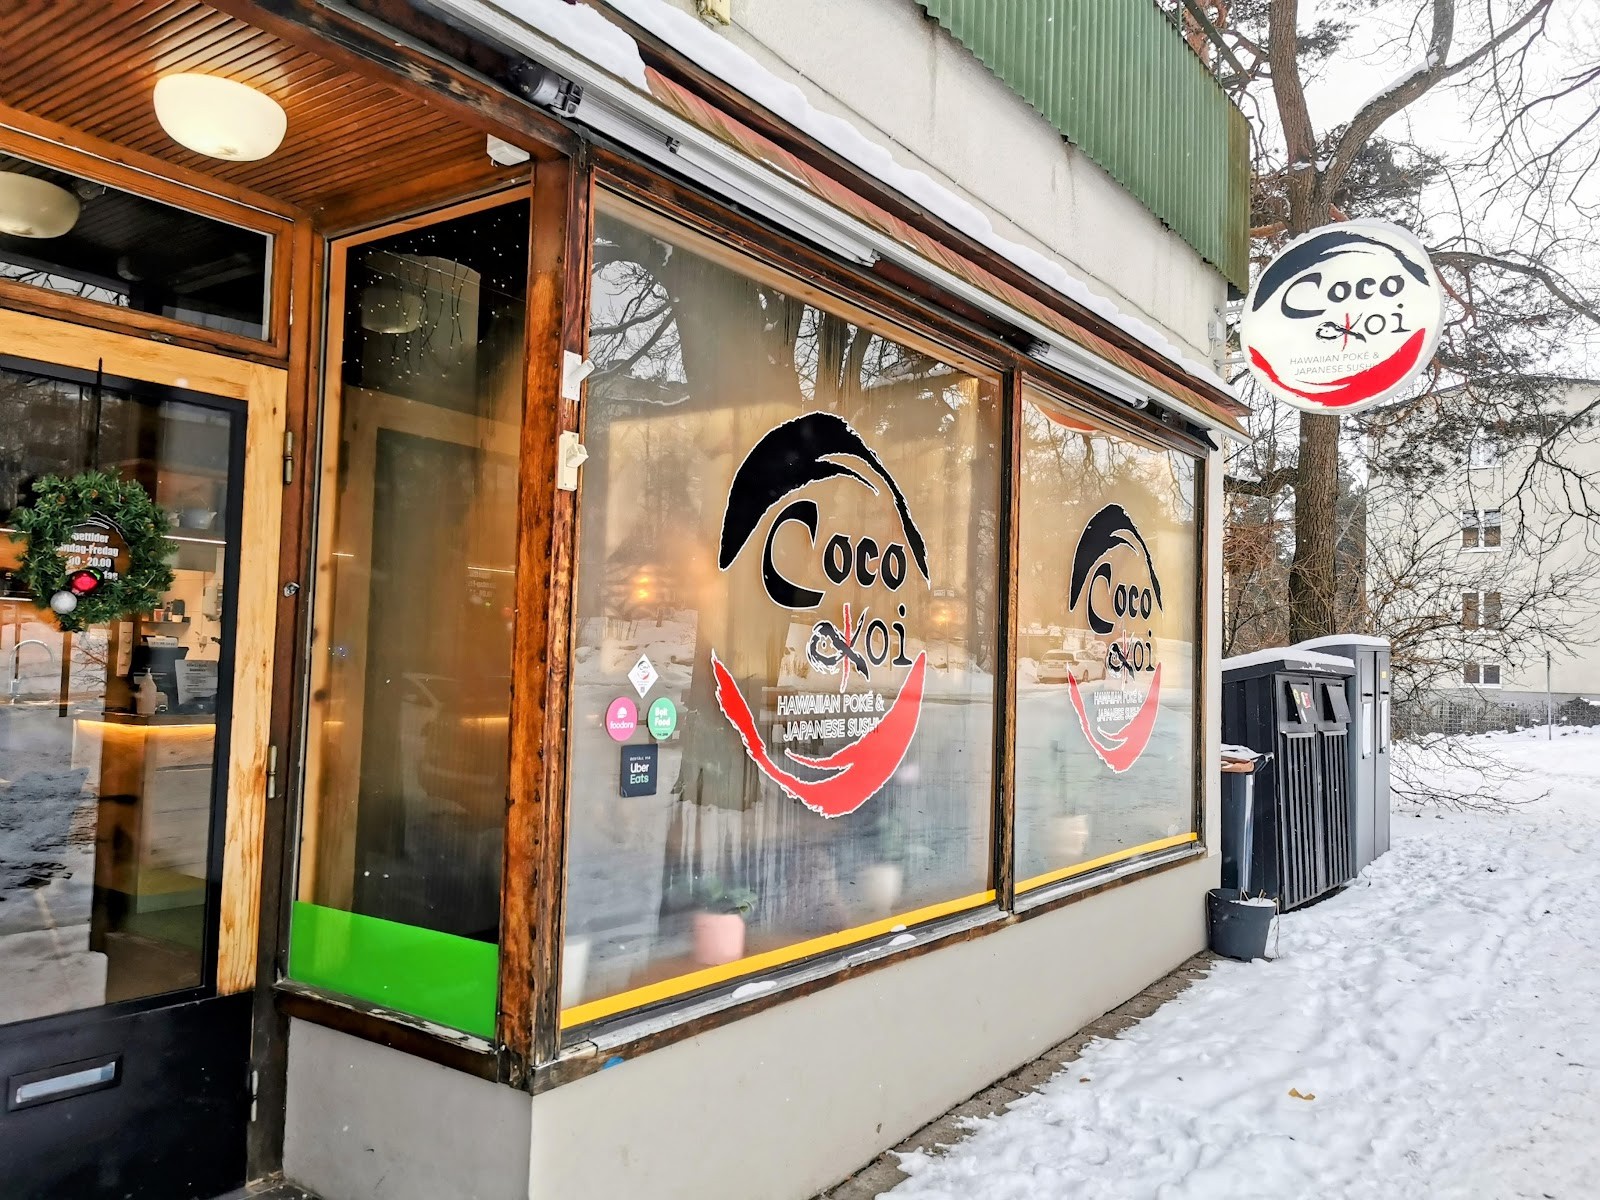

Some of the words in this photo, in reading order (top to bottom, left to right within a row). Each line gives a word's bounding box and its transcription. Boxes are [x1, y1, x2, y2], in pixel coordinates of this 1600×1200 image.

[1281, 272, 1405, 319] Coco
[1290, 354, 1339, 365] HAWAIIAN
[1372, 352, 1380, 360] &
[1294, 365, 1343, 376] JAPANESE
[761, 499, 907, 609] Coco
[1087, 562, 1152, 635] Coco
[777, 694, 840, 715] HAWAIIAN
[843, 690, 873, 713] POKÉ
[875, 693, 885, 712] &
[609, 720, 634, 729] foodora
[654, 717, 671, 726] Food
[783, 719, 845, 742] JAPANESE
[630, 762, 649, 773] Uber
[630, 773, 649, 784] Eats
